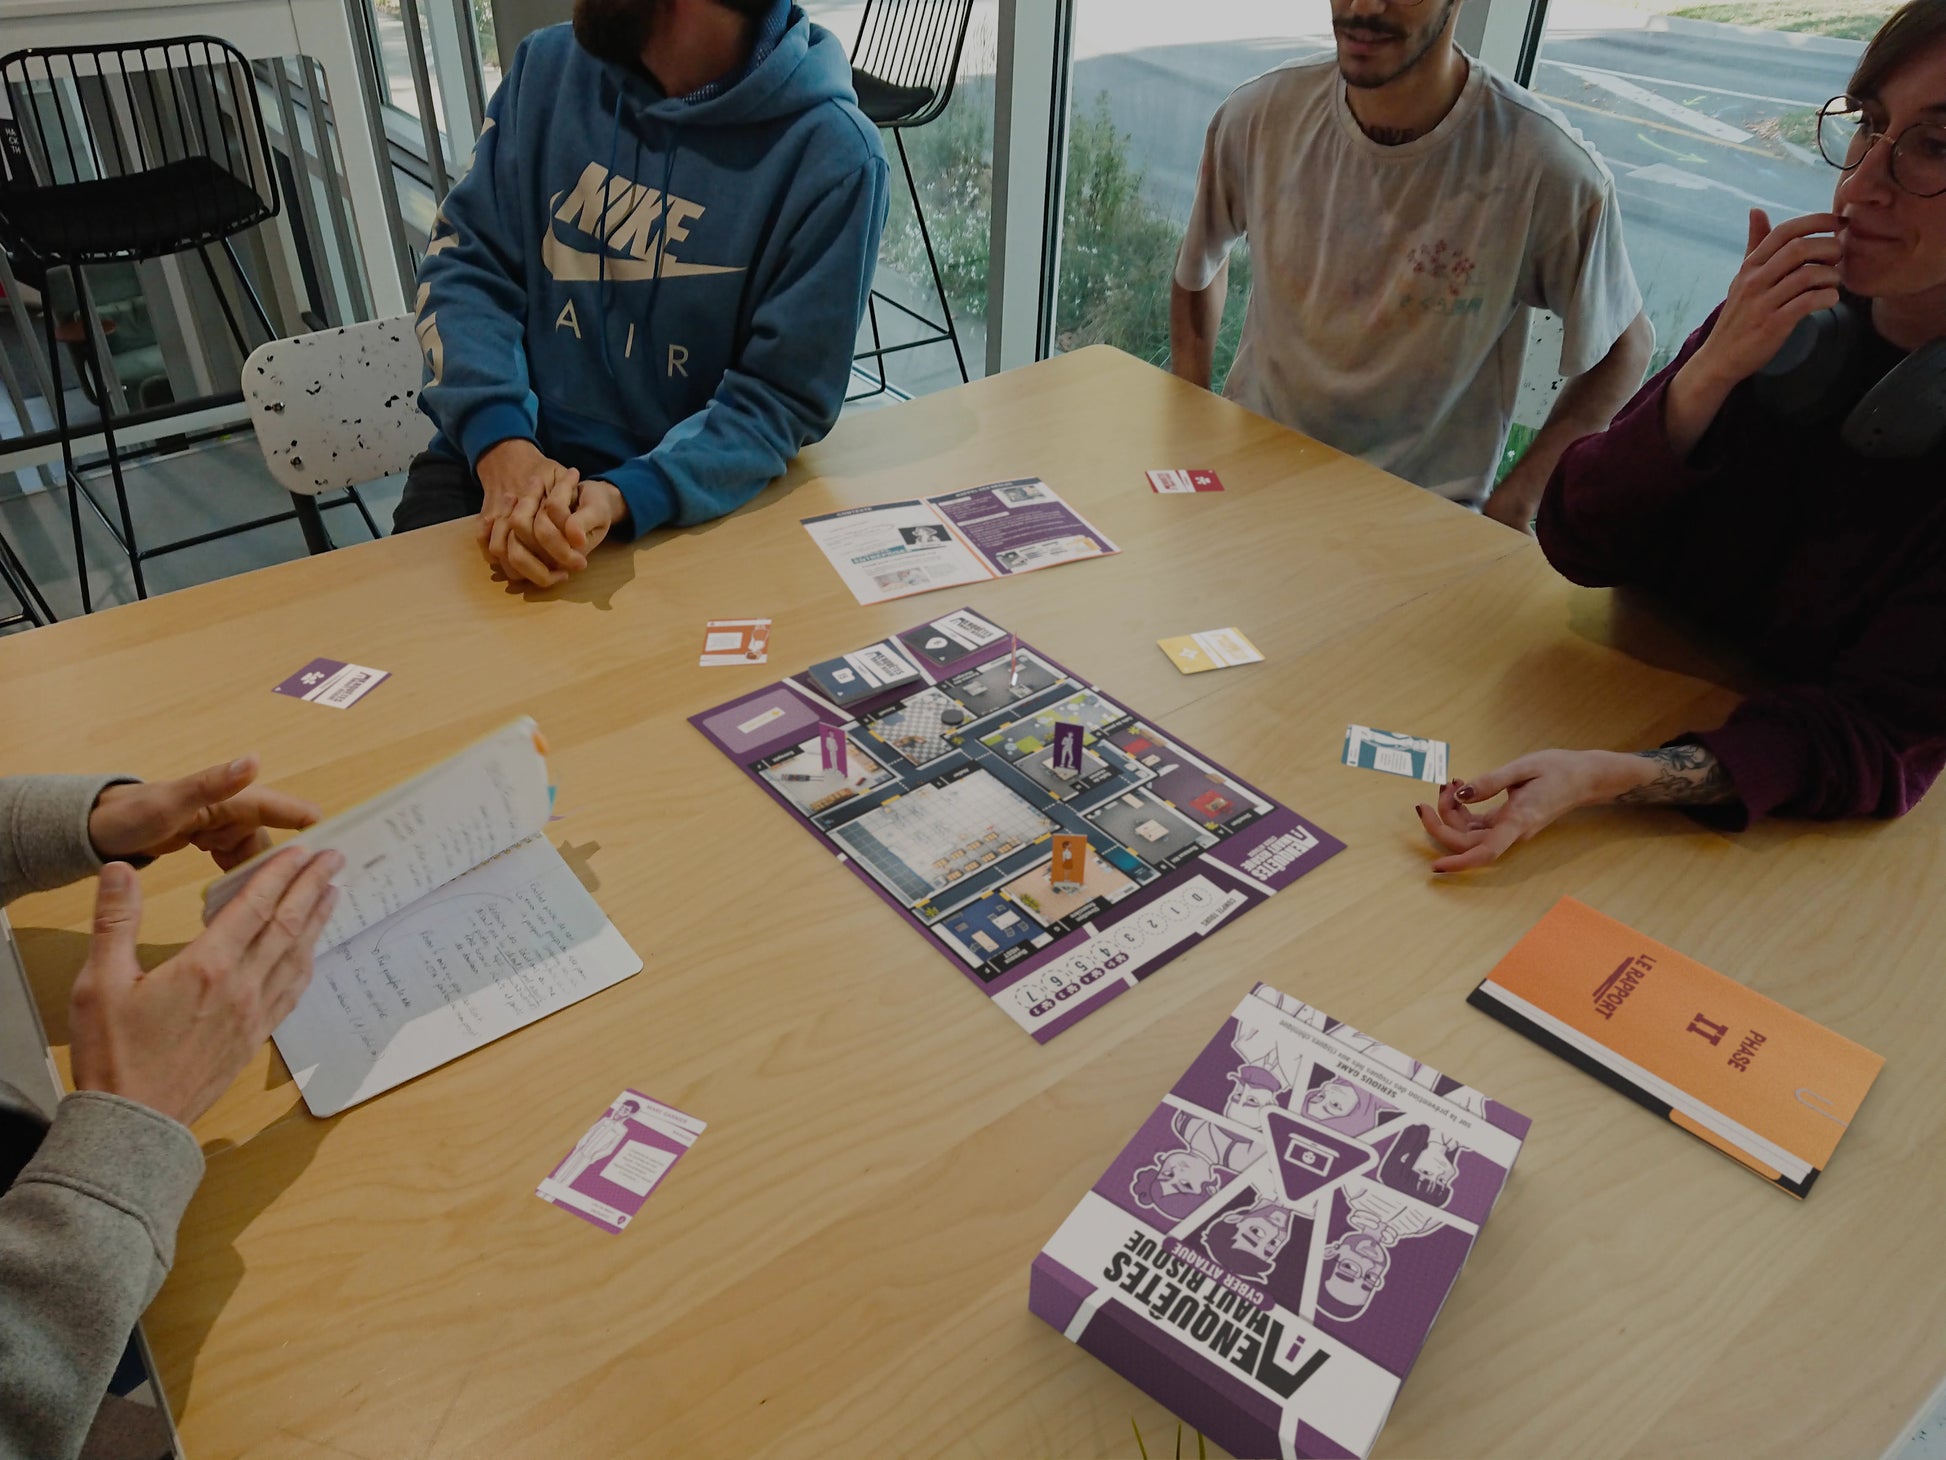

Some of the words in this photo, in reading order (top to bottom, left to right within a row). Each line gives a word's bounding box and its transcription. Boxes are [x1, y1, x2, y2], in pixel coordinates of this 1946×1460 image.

[554, 161, 706, 264] NIKE
[1149, 919, 1159, 930] 2
[1123, 932, 1136, 943] 3
[1099, 947, 1112, 958] 4
[1636, 953, 1657, 972] LE
[1075, 960, 1089, 973] 5
[1050, 975, 1064, 988] 6
[1026, 990, 1038, 1003] 7
[1592, 967, 1645, 1021] RAPPORT
[1686, 1012, 1729, 1047] II
[1727, 1029, 1768, 1073] PHASE
[1335, 1061, 1360, 1079] GAME
[1366, 1067, 1396, 1087] risques
[1361, 1073, 1398, 1099] SERIOUS
[1393, 1083, 1407, 1095] des
[1124, 1230, 1204, 1294] RISQUE
[1171, 1241, 1225, 1281] ATTAQUE
[1221, 1267, 1265, 1305] CYBER
[1103, 1252, 1263, 1377] ENQUÊTES
[1204, 1280, 1271, 1339] HAUT
